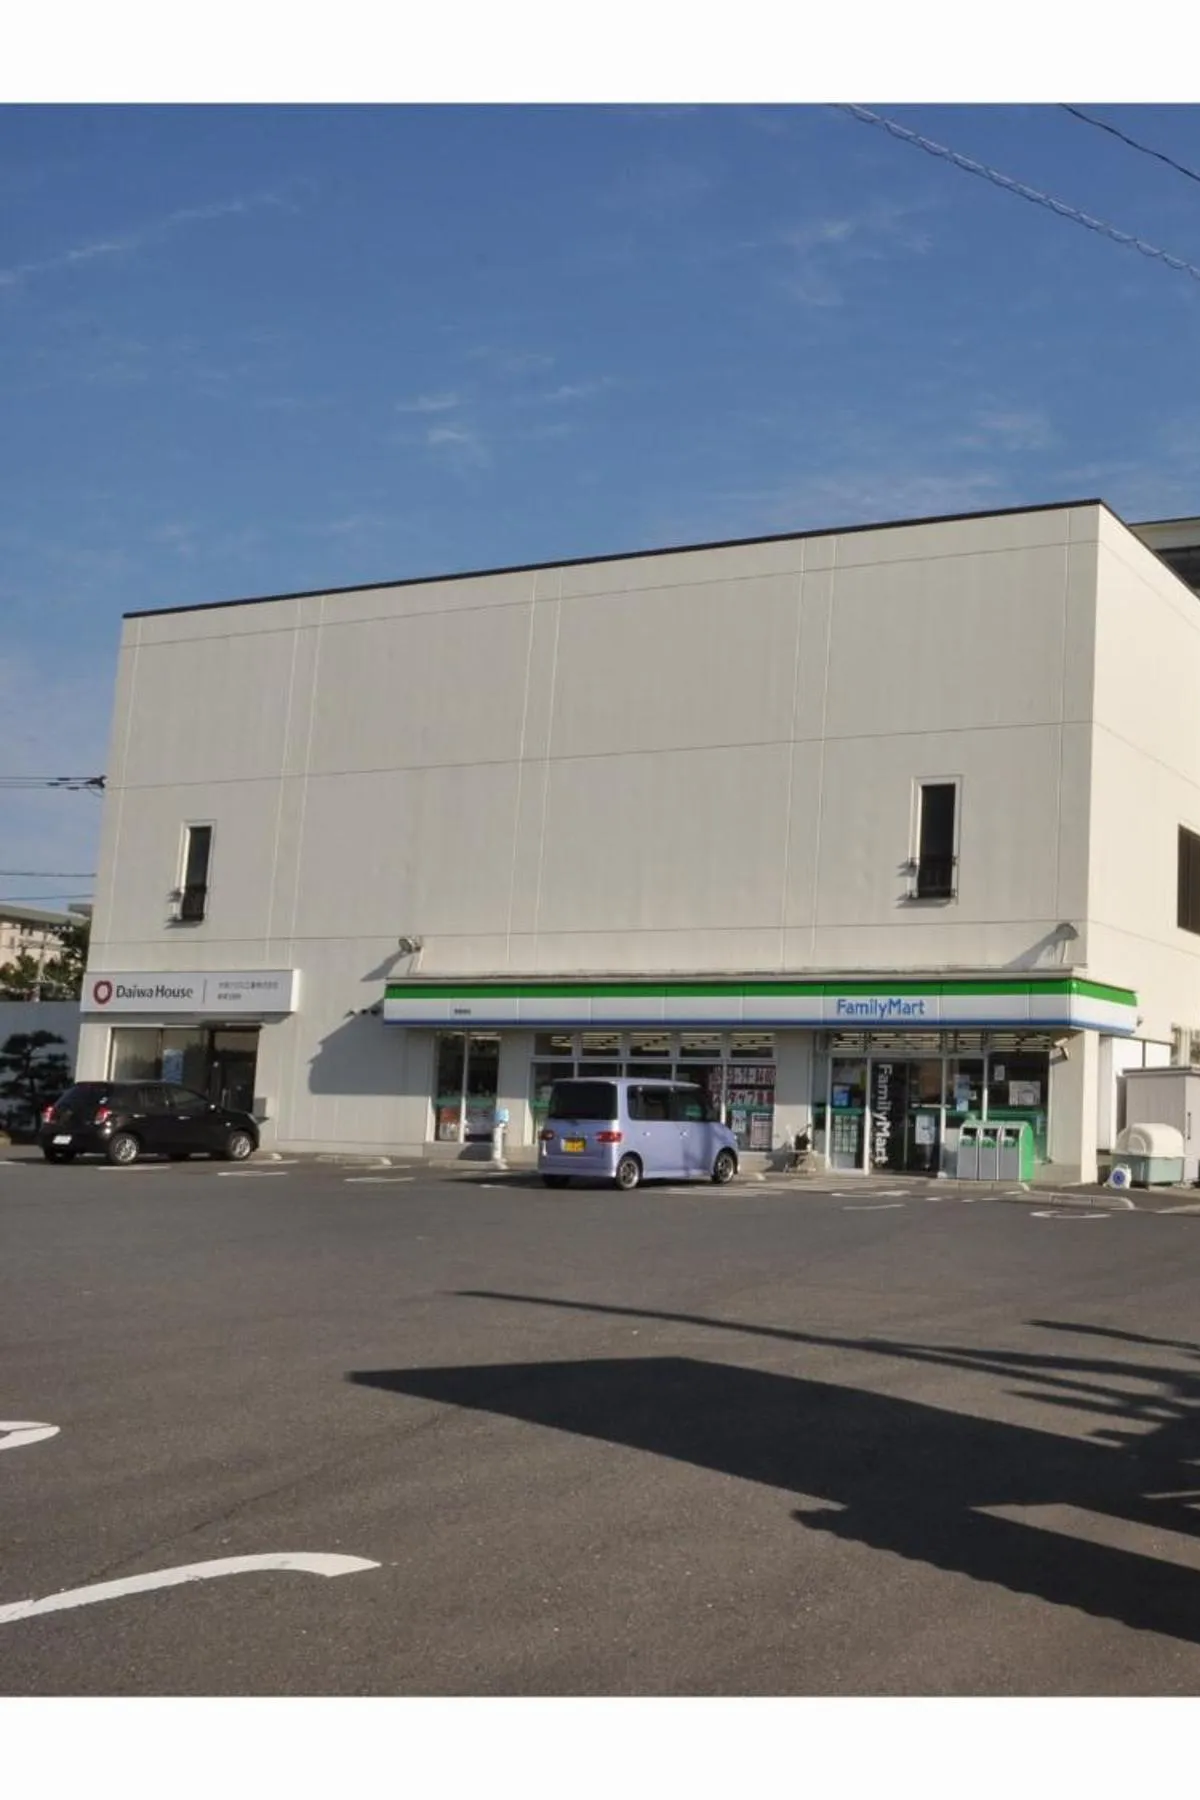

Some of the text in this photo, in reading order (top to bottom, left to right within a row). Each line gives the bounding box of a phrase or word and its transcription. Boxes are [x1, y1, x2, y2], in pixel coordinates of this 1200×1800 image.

[116, 985, 194, 999] Daiwa House
[836, 998, 926, 1019] FamilyMart
[872, 1064, 893, 1164] FamilyMart
